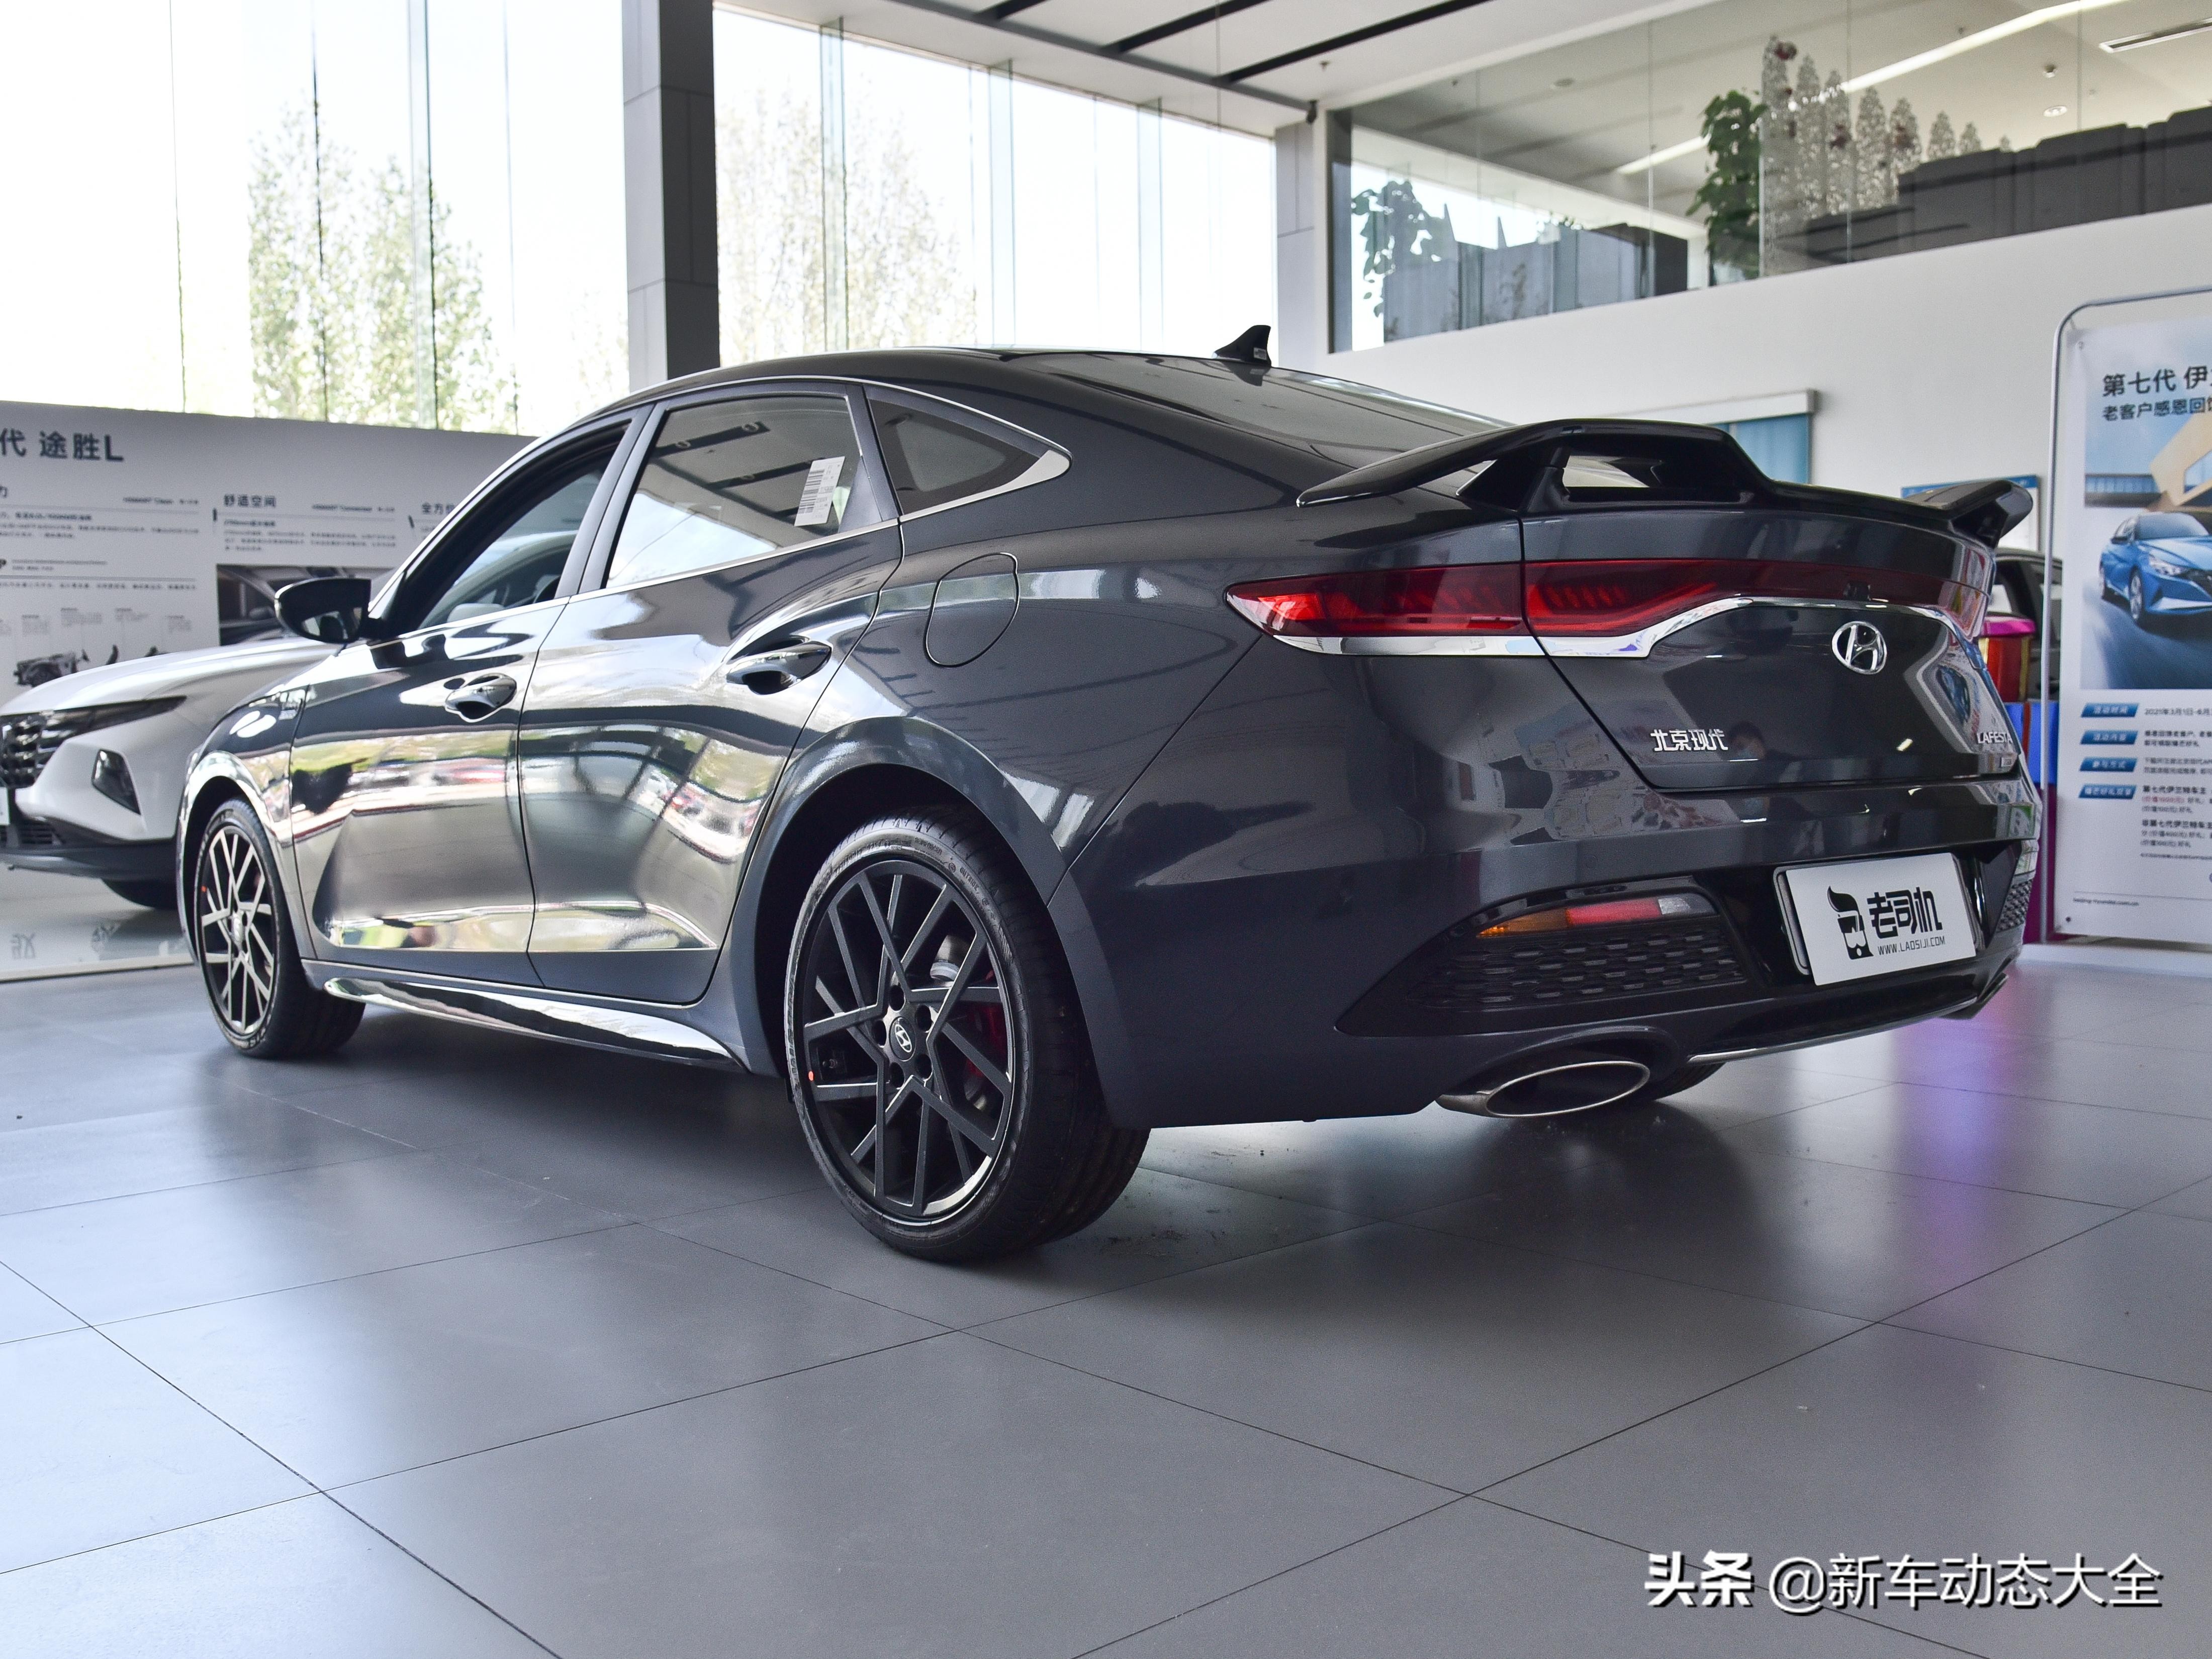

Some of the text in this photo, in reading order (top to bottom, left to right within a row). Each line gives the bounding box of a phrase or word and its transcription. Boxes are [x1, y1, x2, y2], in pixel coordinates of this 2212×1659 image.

[2102, 365, 2212, 397] 第七代 伊
[0, 427, 124, 462] 代 途胜L
[1650, 728, 1729, 752] 北京现代
[1976, 730, 2013, 744] LAFESTA
[1866, 886, 1943, 939] 老司机
[1877, 936, 1946, 956] WWW.LAOSIJI.COM
